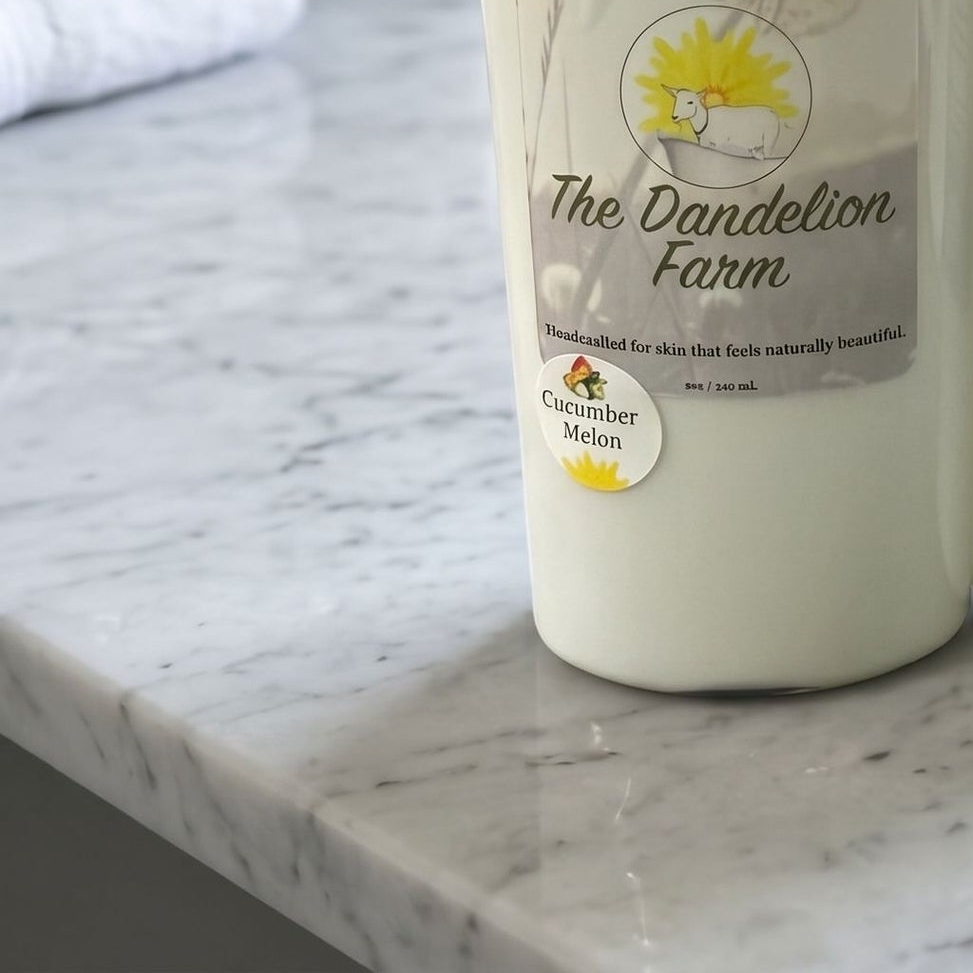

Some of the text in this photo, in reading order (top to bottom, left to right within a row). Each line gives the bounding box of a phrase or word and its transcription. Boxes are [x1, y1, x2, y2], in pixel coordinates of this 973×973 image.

[551, 174, 895, 237] The Dandelion
[652, 240, 791, 290] Farm
[631, 339, 651, 353] for
[656, 342, 686, 357] skin
[691, 344, 721, 357] that
[726, 344, 761, 357] feels
[766, 338, 834, 355] naturally
[838, 325, 906, 349] beautiful.
[542, 390, 638, 425] Cucumber
[563, 422, 622, 449] Melon
